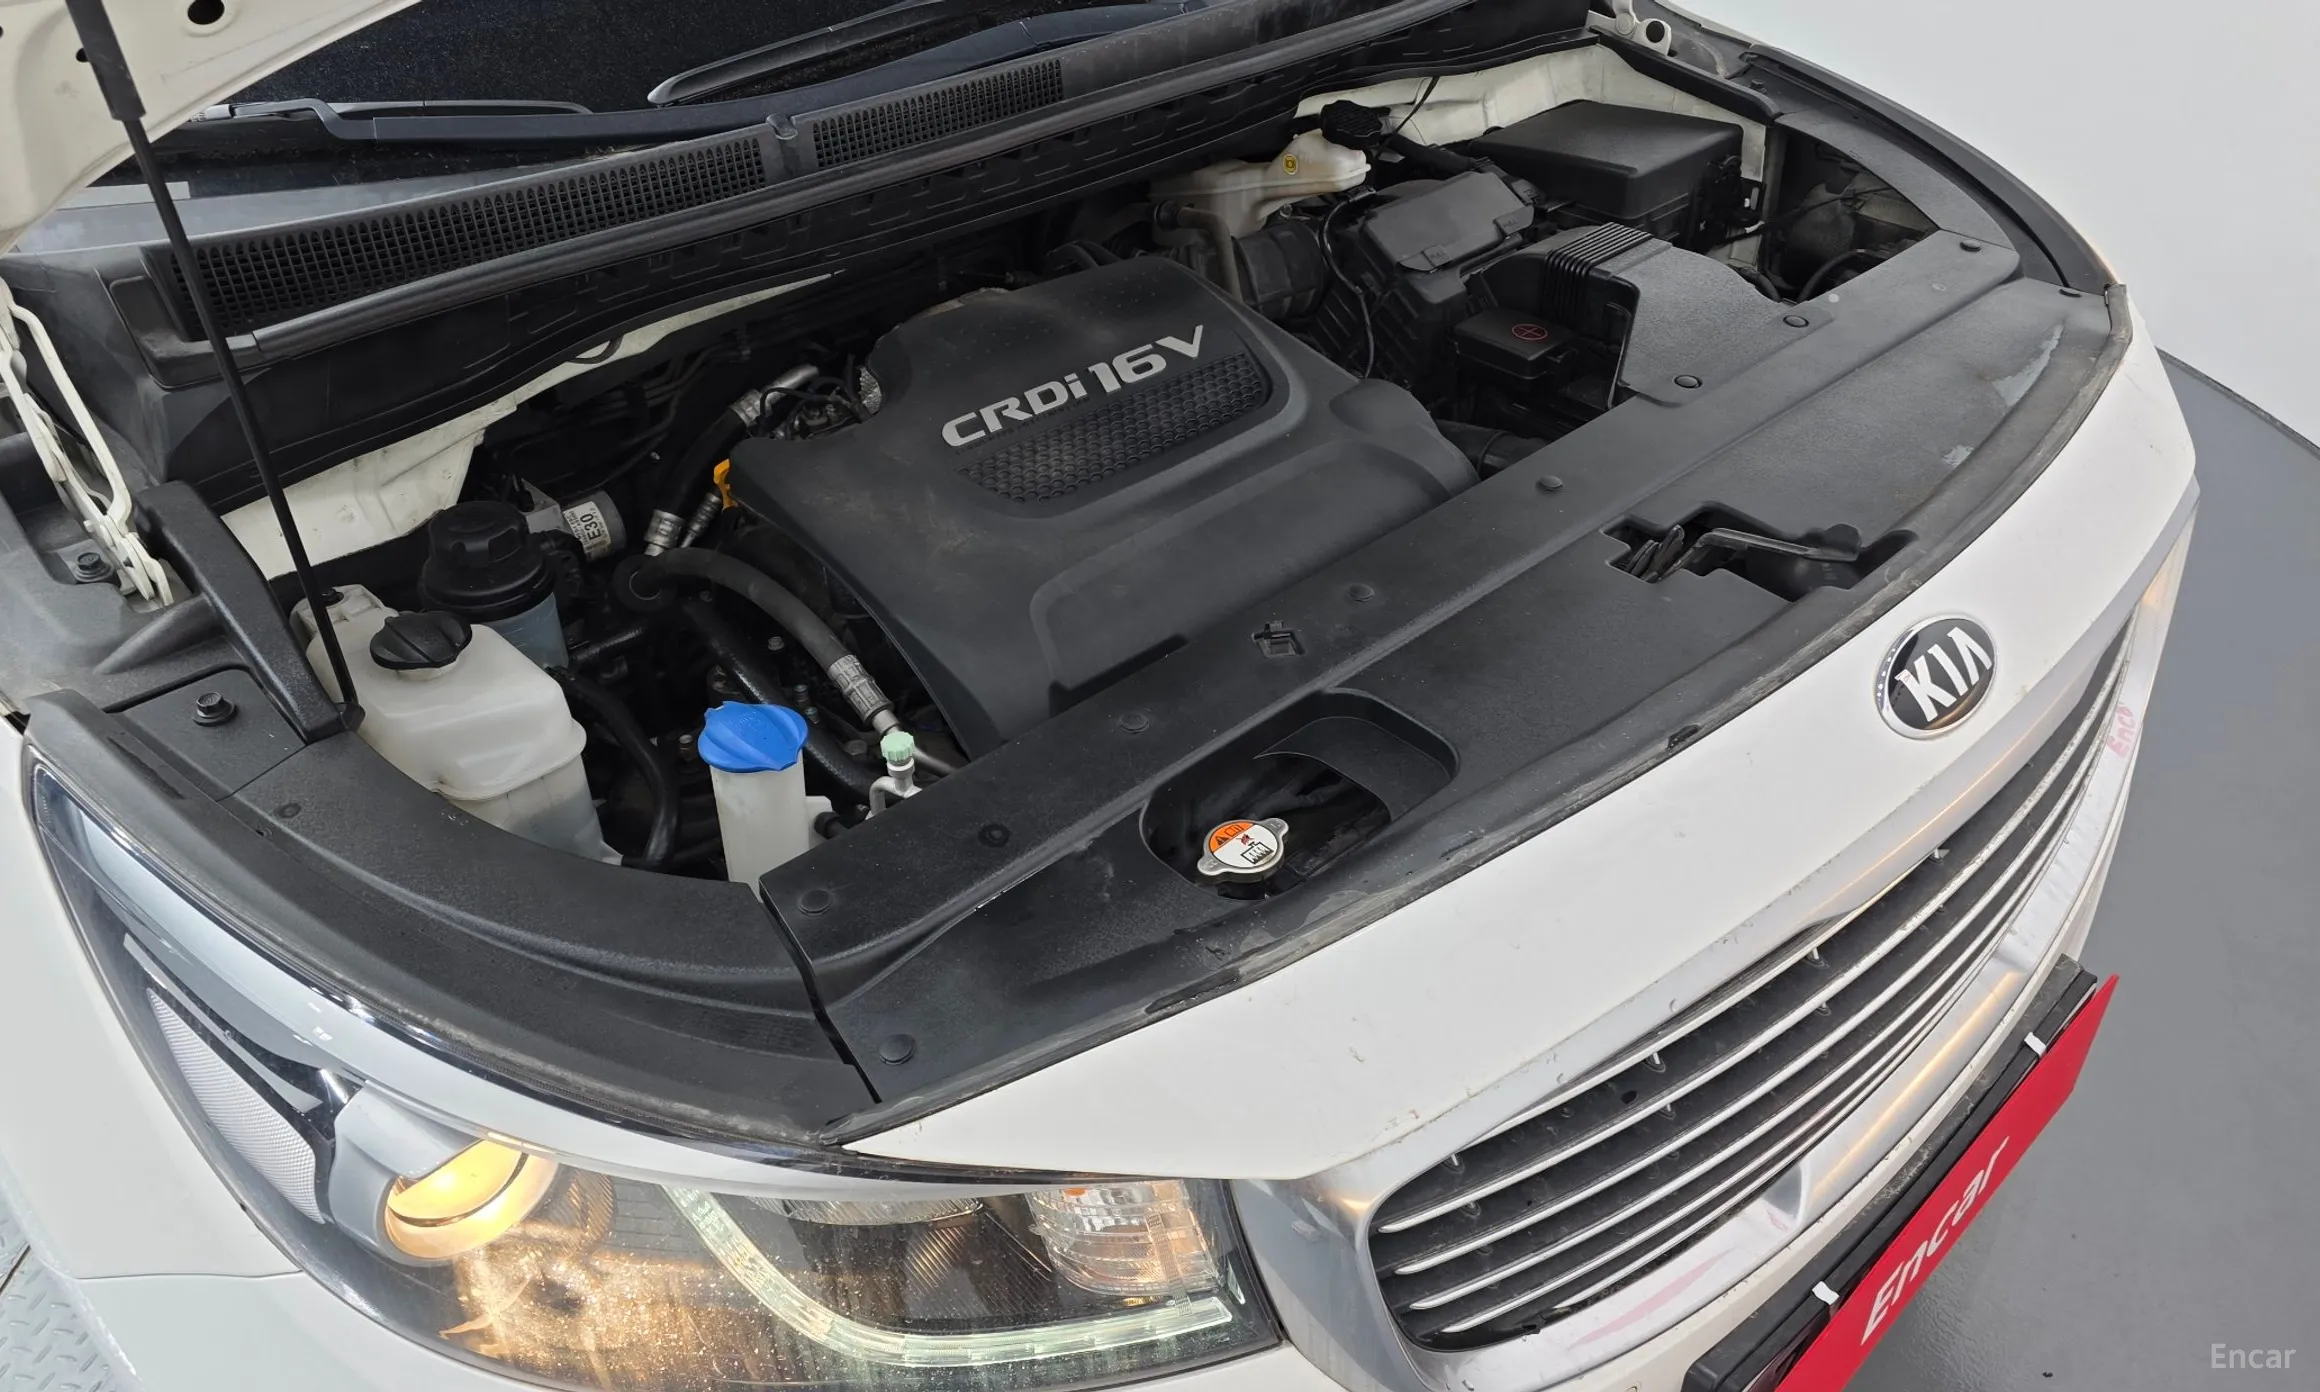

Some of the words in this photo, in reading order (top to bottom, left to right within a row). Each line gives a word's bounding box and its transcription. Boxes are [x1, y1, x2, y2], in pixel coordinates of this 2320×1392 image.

[941, 372, 1088, 447] CRDi
[1087, 324, 1204, 394] 16V
[580, 513, 602, 541] E30
[1893, 626, 1993, 722] KIA
[1860, 1135, 2010, 1346] Encar
